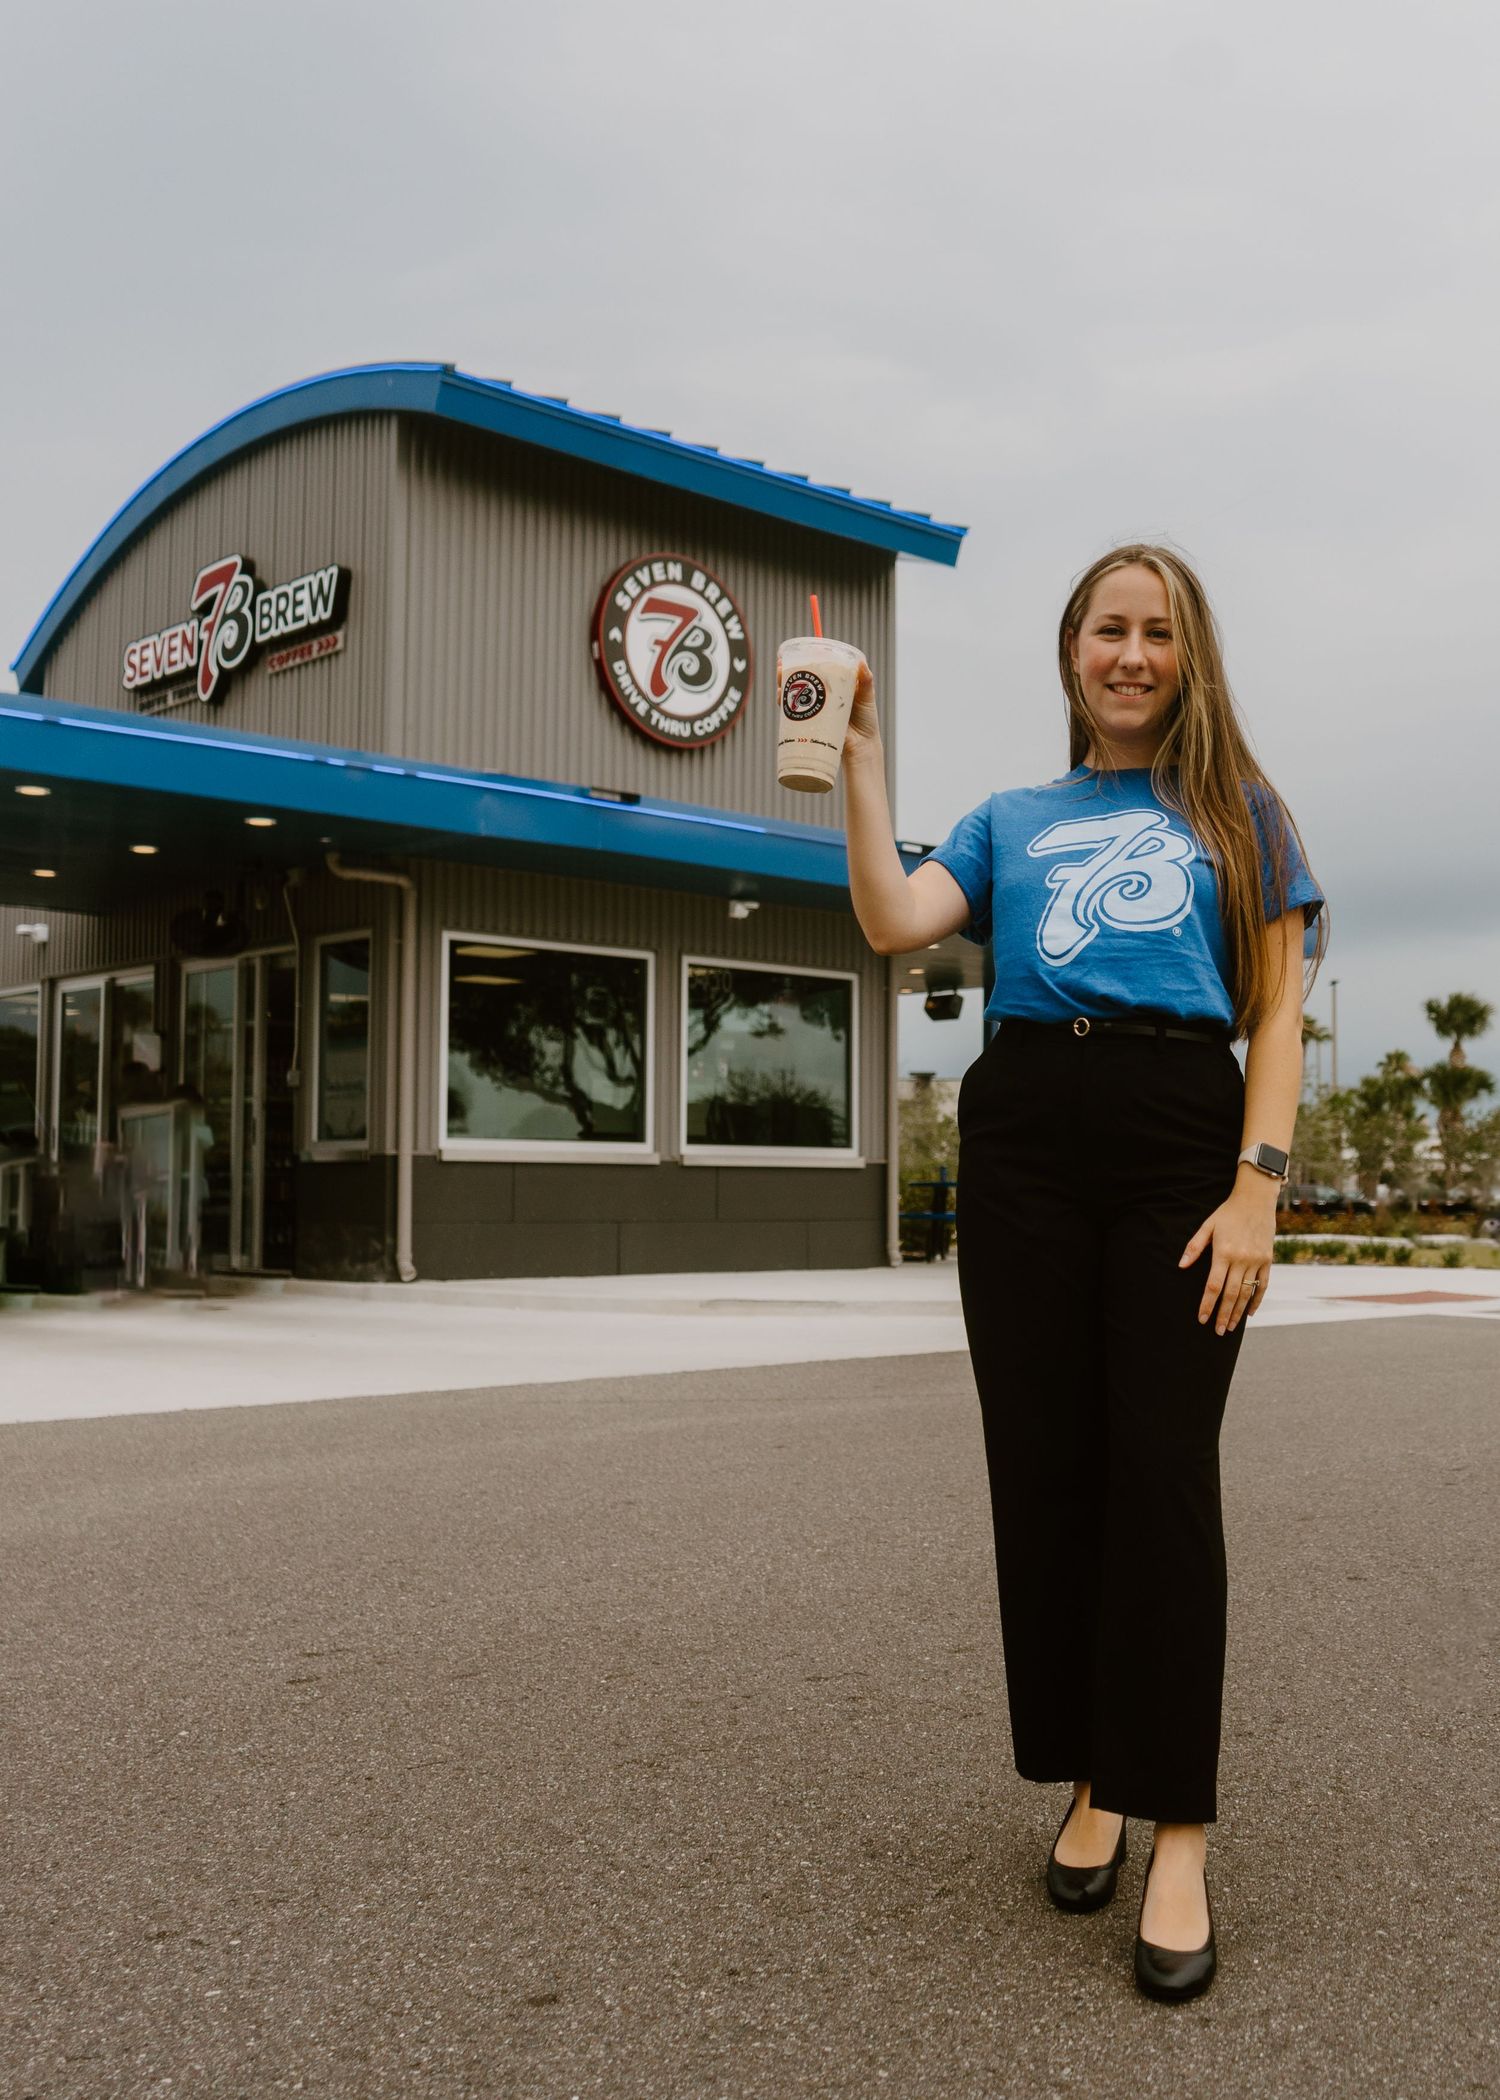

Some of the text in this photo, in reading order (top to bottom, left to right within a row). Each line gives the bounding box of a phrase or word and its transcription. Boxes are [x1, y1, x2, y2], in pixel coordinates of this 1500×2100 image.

[124, 620, 198, 687] SEVEN
[256, 565, 338, 641] BREW
[615, 561, 745, 641] SEVEN BREW
[612, 659, 743, 738] DRIVE THRU COFFEE
